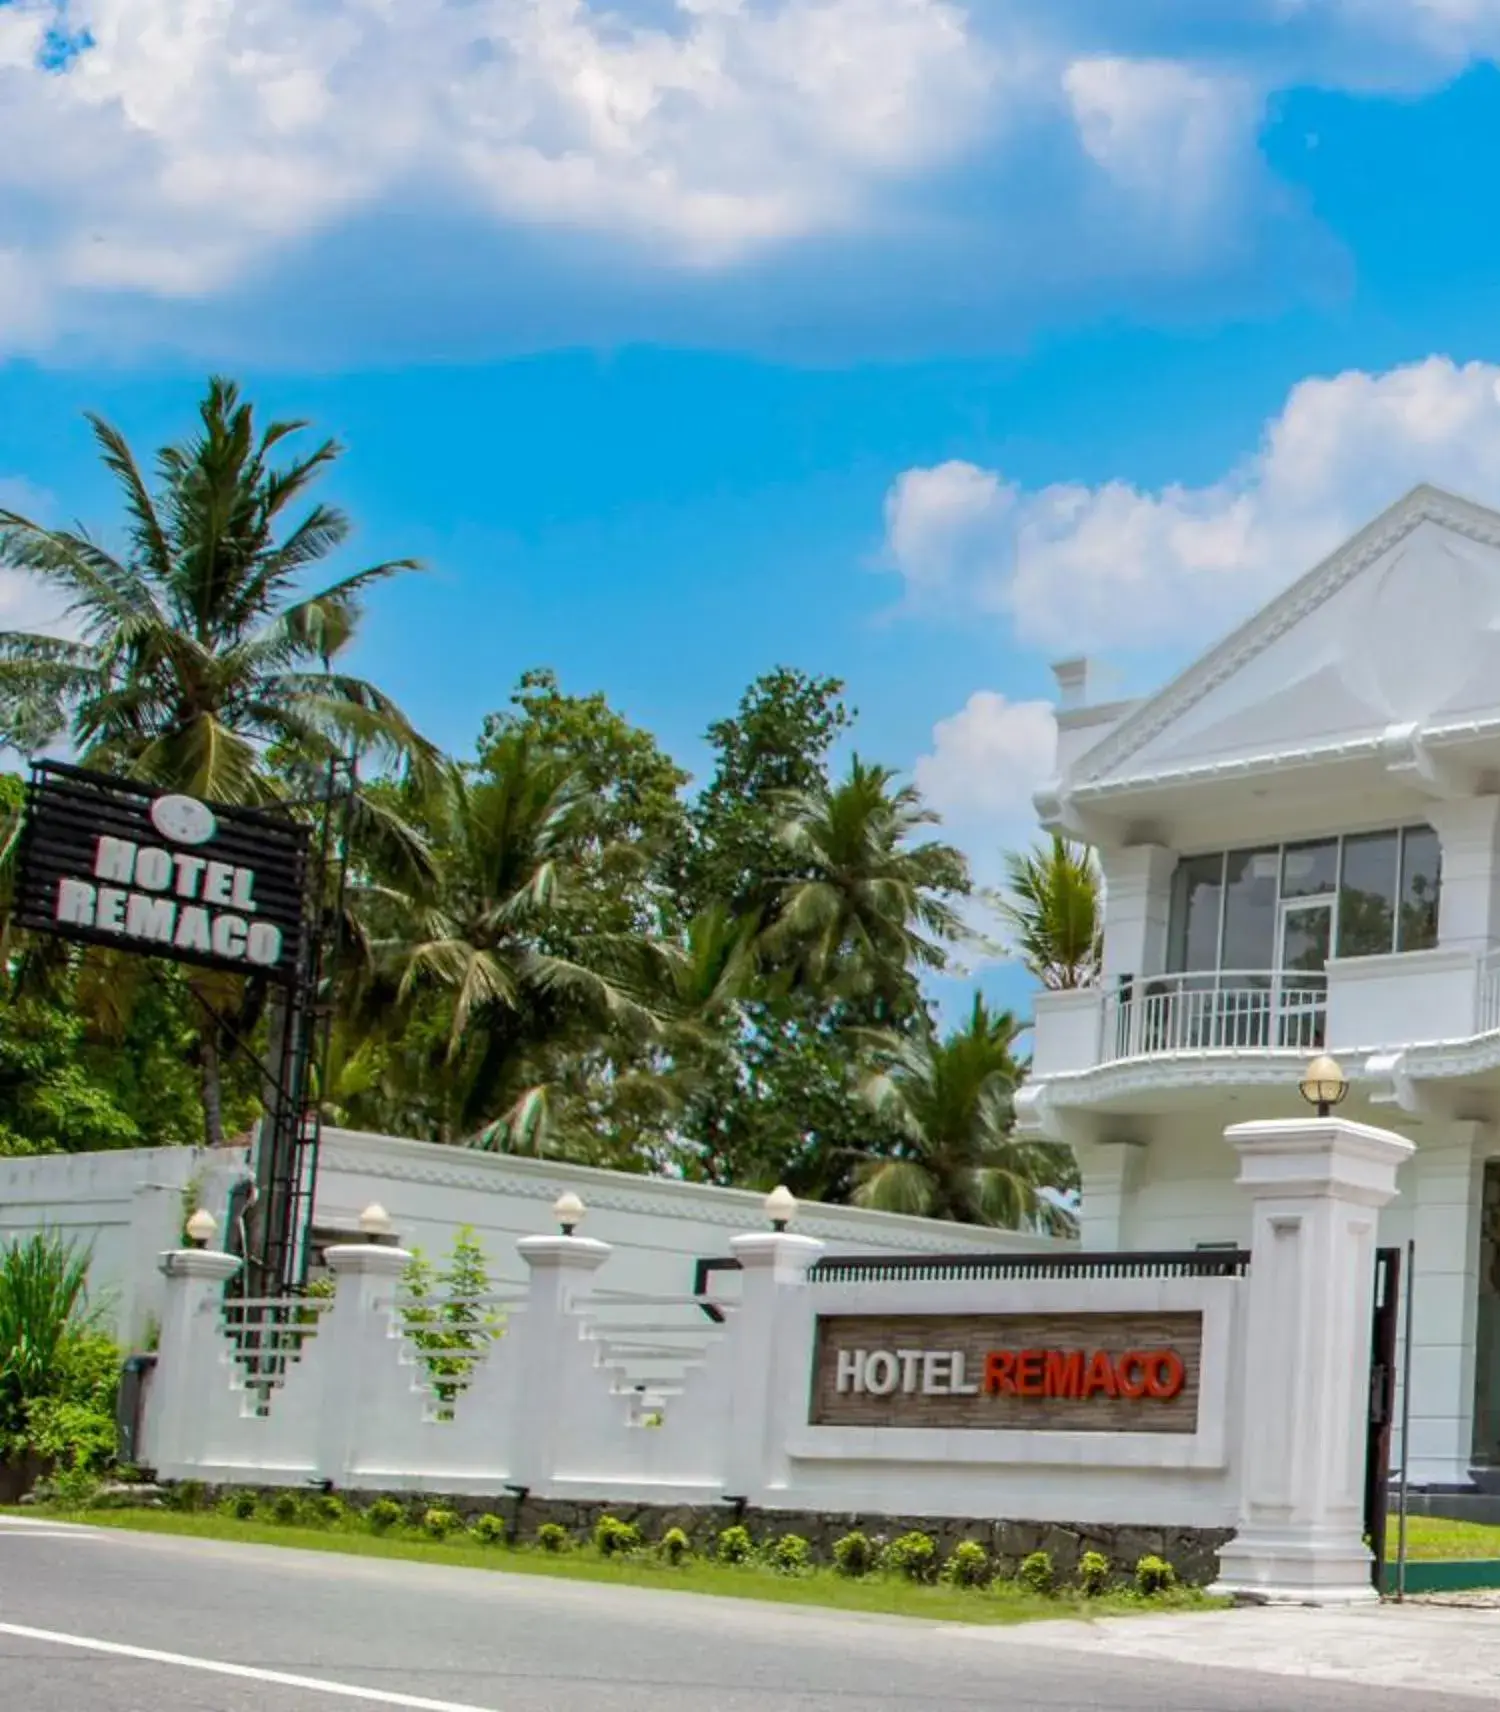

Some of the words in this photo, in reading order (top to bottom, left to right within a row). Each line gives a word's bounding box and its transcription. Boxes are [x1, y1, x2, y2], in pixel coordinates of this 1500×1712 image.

[94, 835, 257, 912] HOTEL
[56, 877, 284, 966] REMACO
[836, 1349, 979, 1396] HOTEL
[983, 1349, 1186, 1399] REMACO
